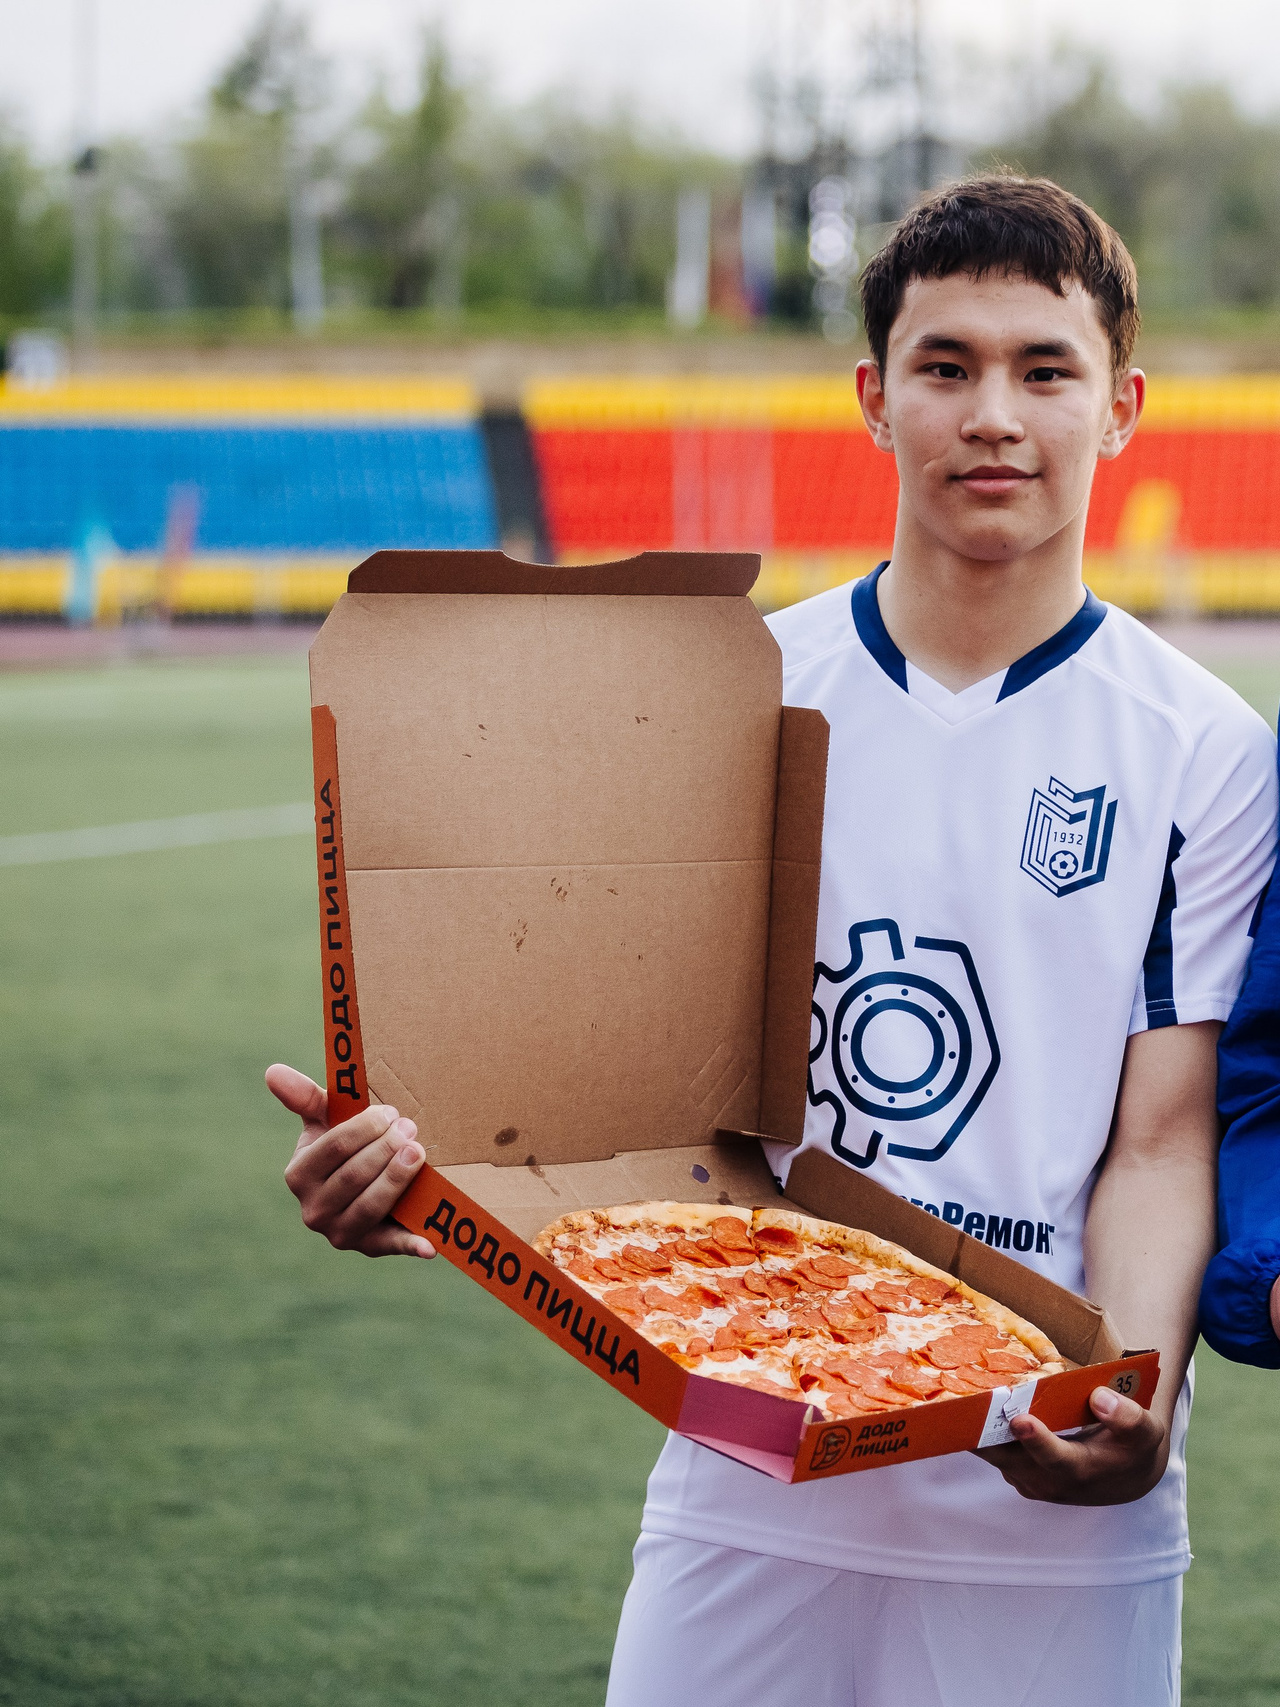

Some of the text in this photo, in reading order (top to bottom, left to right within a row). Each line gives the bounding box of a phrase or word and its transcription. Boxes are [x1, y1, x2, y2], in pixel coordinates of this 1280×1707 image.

[1053, 831, 1084, 846] 1932
[320, 778, 361, 1100] ДОДО ПИЦЦА
[424, 1198, 640, 1386] ДОДО ПИЦЦА
[1116, 1374, 1133, 1393] 35
[856, 1420, 907, 1442] ДОДО
[850, 1436, 909, 1459] ПИЦЦА
